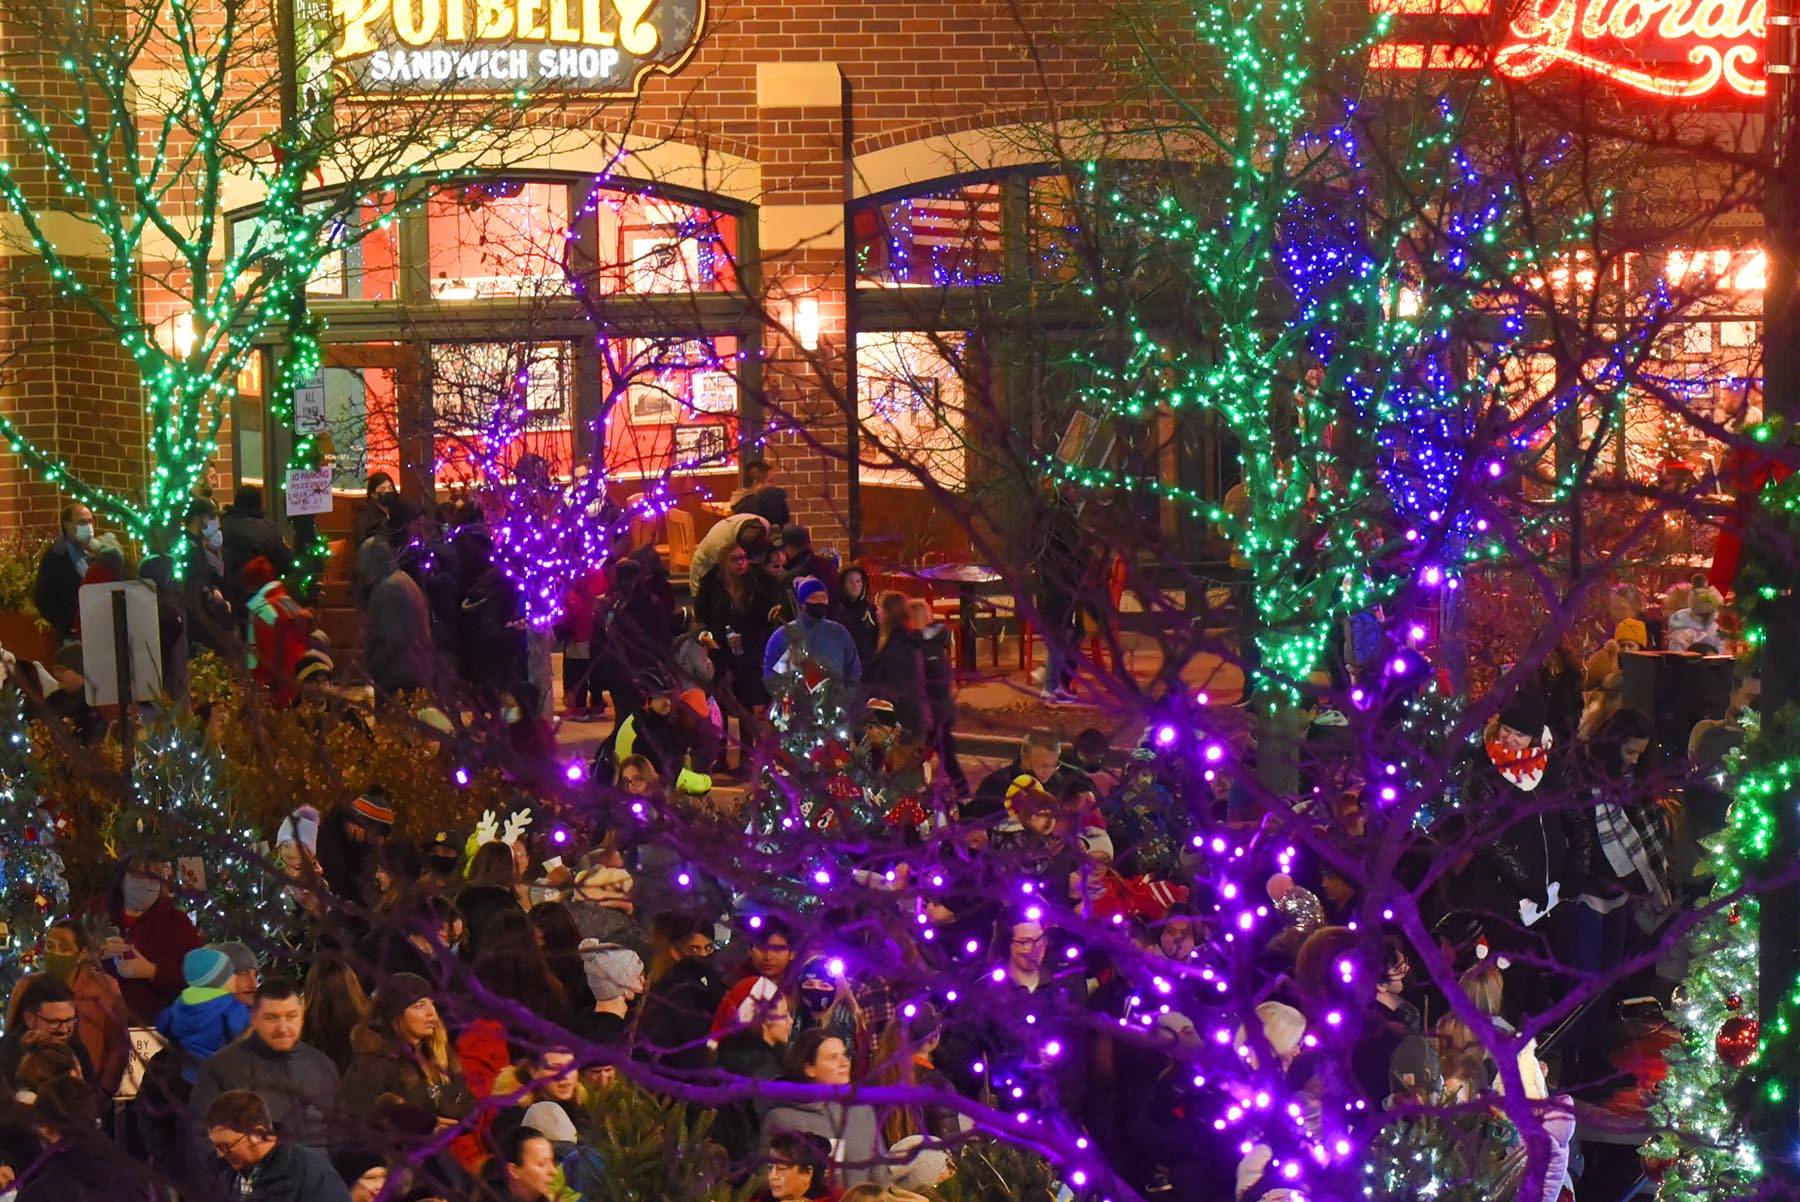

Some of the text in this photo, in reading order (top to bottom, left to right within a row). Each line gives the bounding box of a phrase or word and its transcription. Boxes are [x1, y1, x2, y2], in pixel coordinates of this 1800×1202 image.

[371, 47, 619, 80] SANDWICH SHOP
[136, 1039, 149, 1050] BY
